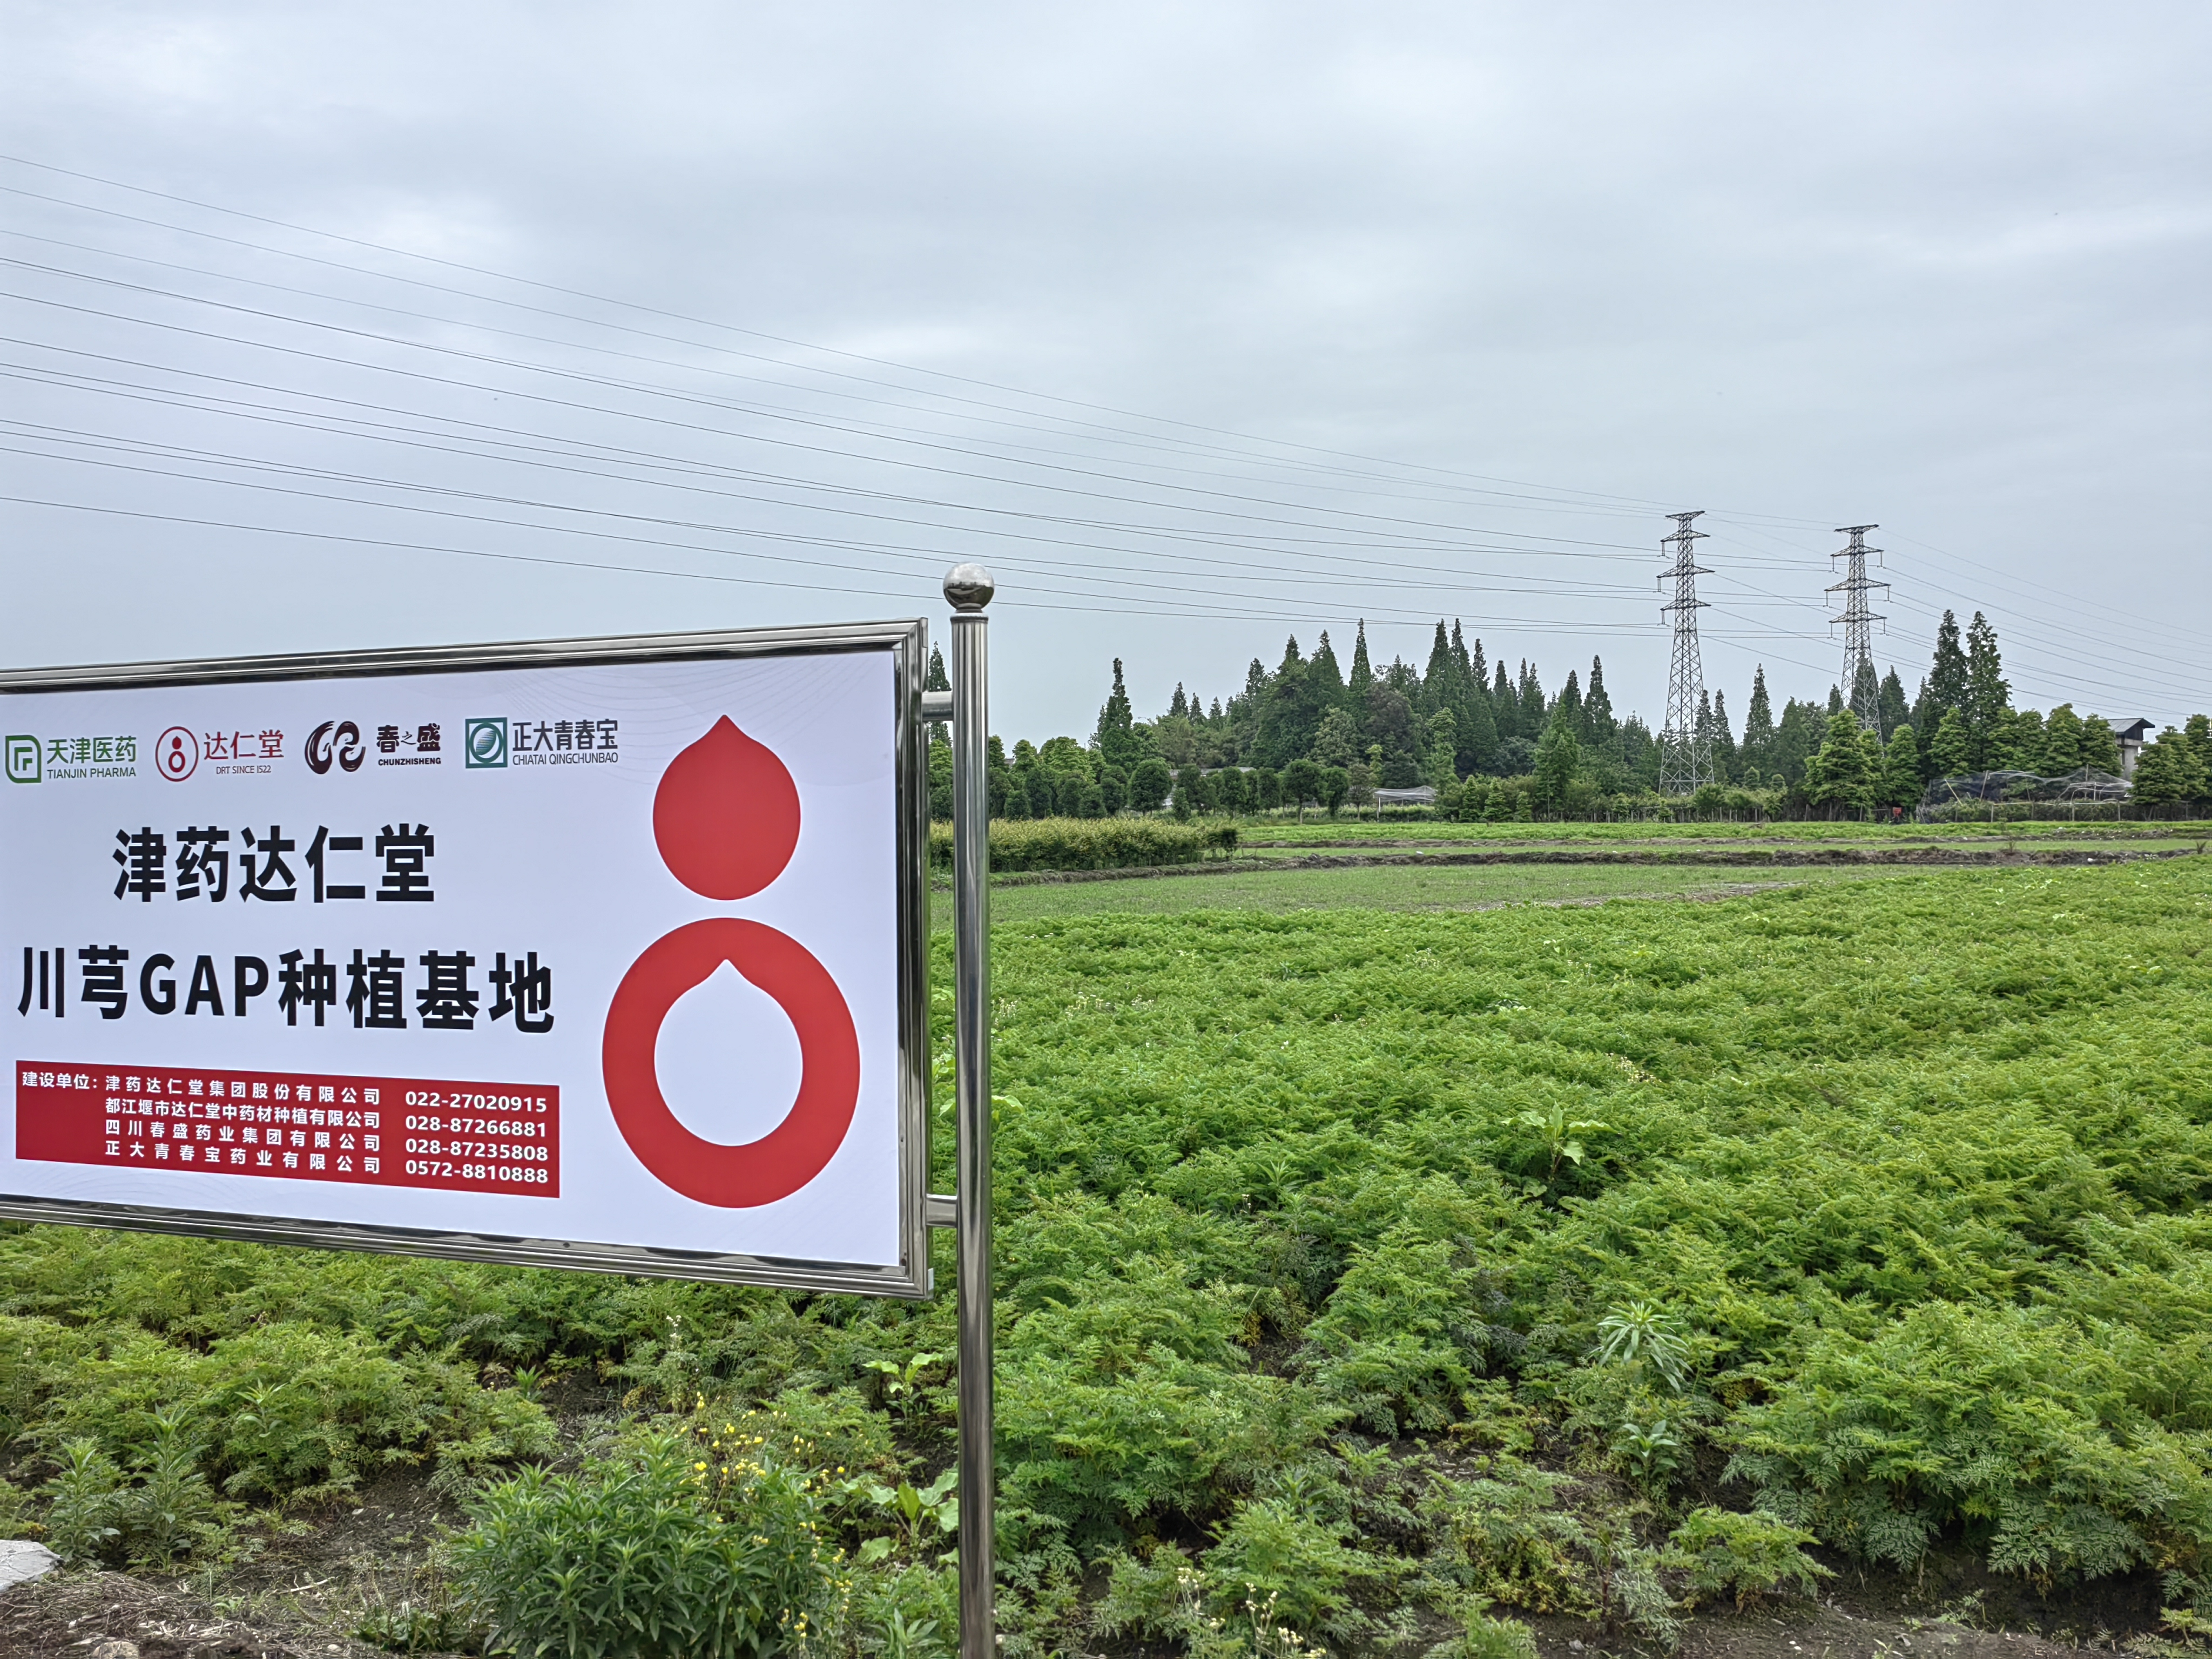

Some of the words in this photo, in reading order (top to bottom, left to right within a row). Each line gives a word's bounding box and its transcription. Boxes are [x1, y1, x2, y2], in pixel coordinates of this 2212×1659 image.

[203, 729, 284, 760] 达仁堂
[376, 723, 441, 753] 春之盛
[512, 719, 618, 752] 正大青春宝
[46, 735, 137, 764] 天津医药
[378, 757, 441, 766] CHUNZHISHENG
[512, 754, 547, 766] CHIATAI
[549, 752, 618, 765] QINGCHUNBAO
[46, 768, 87, 779] TIANJIN
[90, 767, 136, 778] PHARMA
[216, 766, 231, 774] DRT
[232, 765, 255, 774] SINCE
[112, 823, 435, 903] 津药达仁堂
[17, 944, 555, 1034] 川芎GAP种植基地
[105, 1097, 380, 1129] 都江堰市达仁堂中药材种植有限公司
[406, 1091, 547, 1112] 022-27020915
[406, 1115, 545, 1137] 028-87266881
[406, 1138, 548, 1161] 028-87235808
[406, 1159, 548, 1183] 0572-8810888
